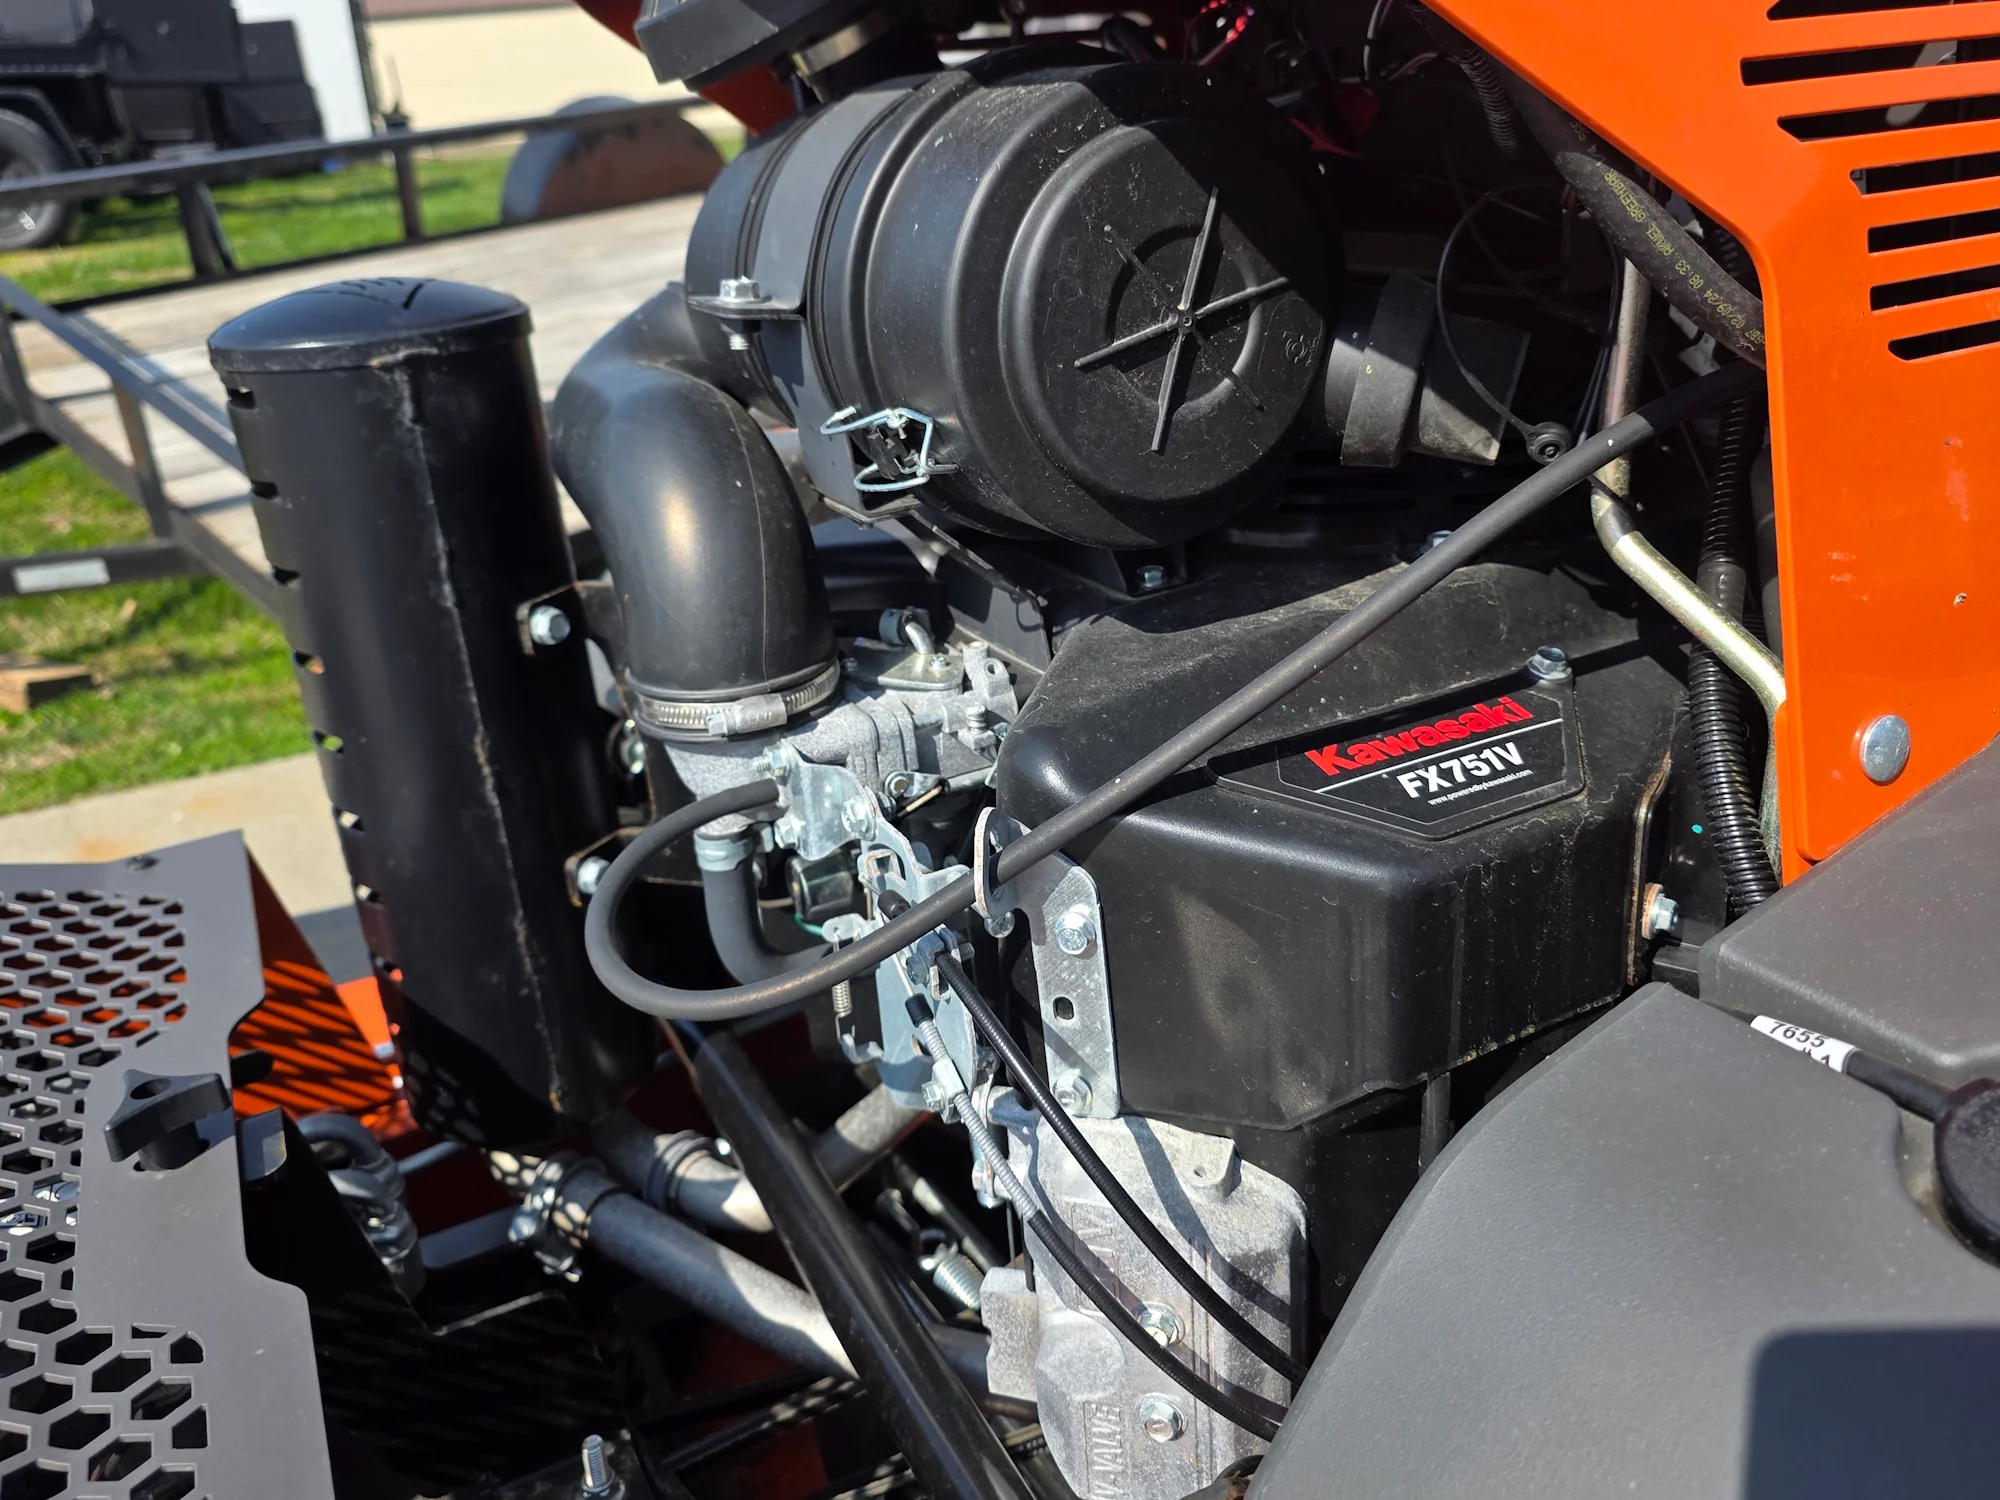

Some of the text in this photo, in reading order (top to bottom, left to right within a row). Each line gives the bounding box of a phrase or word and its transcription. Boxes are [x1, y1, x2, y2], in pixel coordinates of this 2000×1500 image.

[1603, 168, 1646, 224] GREENBAR
[1646, 221, 1675, 256] AKWEL
[1675, 259, 1704, 289] 08:33
[1703, 288, 1745, 330] 02/09/24
[1304, 696, 1534, 776] Kawasaki
[1396, 742, 1524, 799] FX751V
[1427, 769, 1534, 806] www.poweredbykawasaki.com
[1769, 1021, 1830, 1048] 7655
